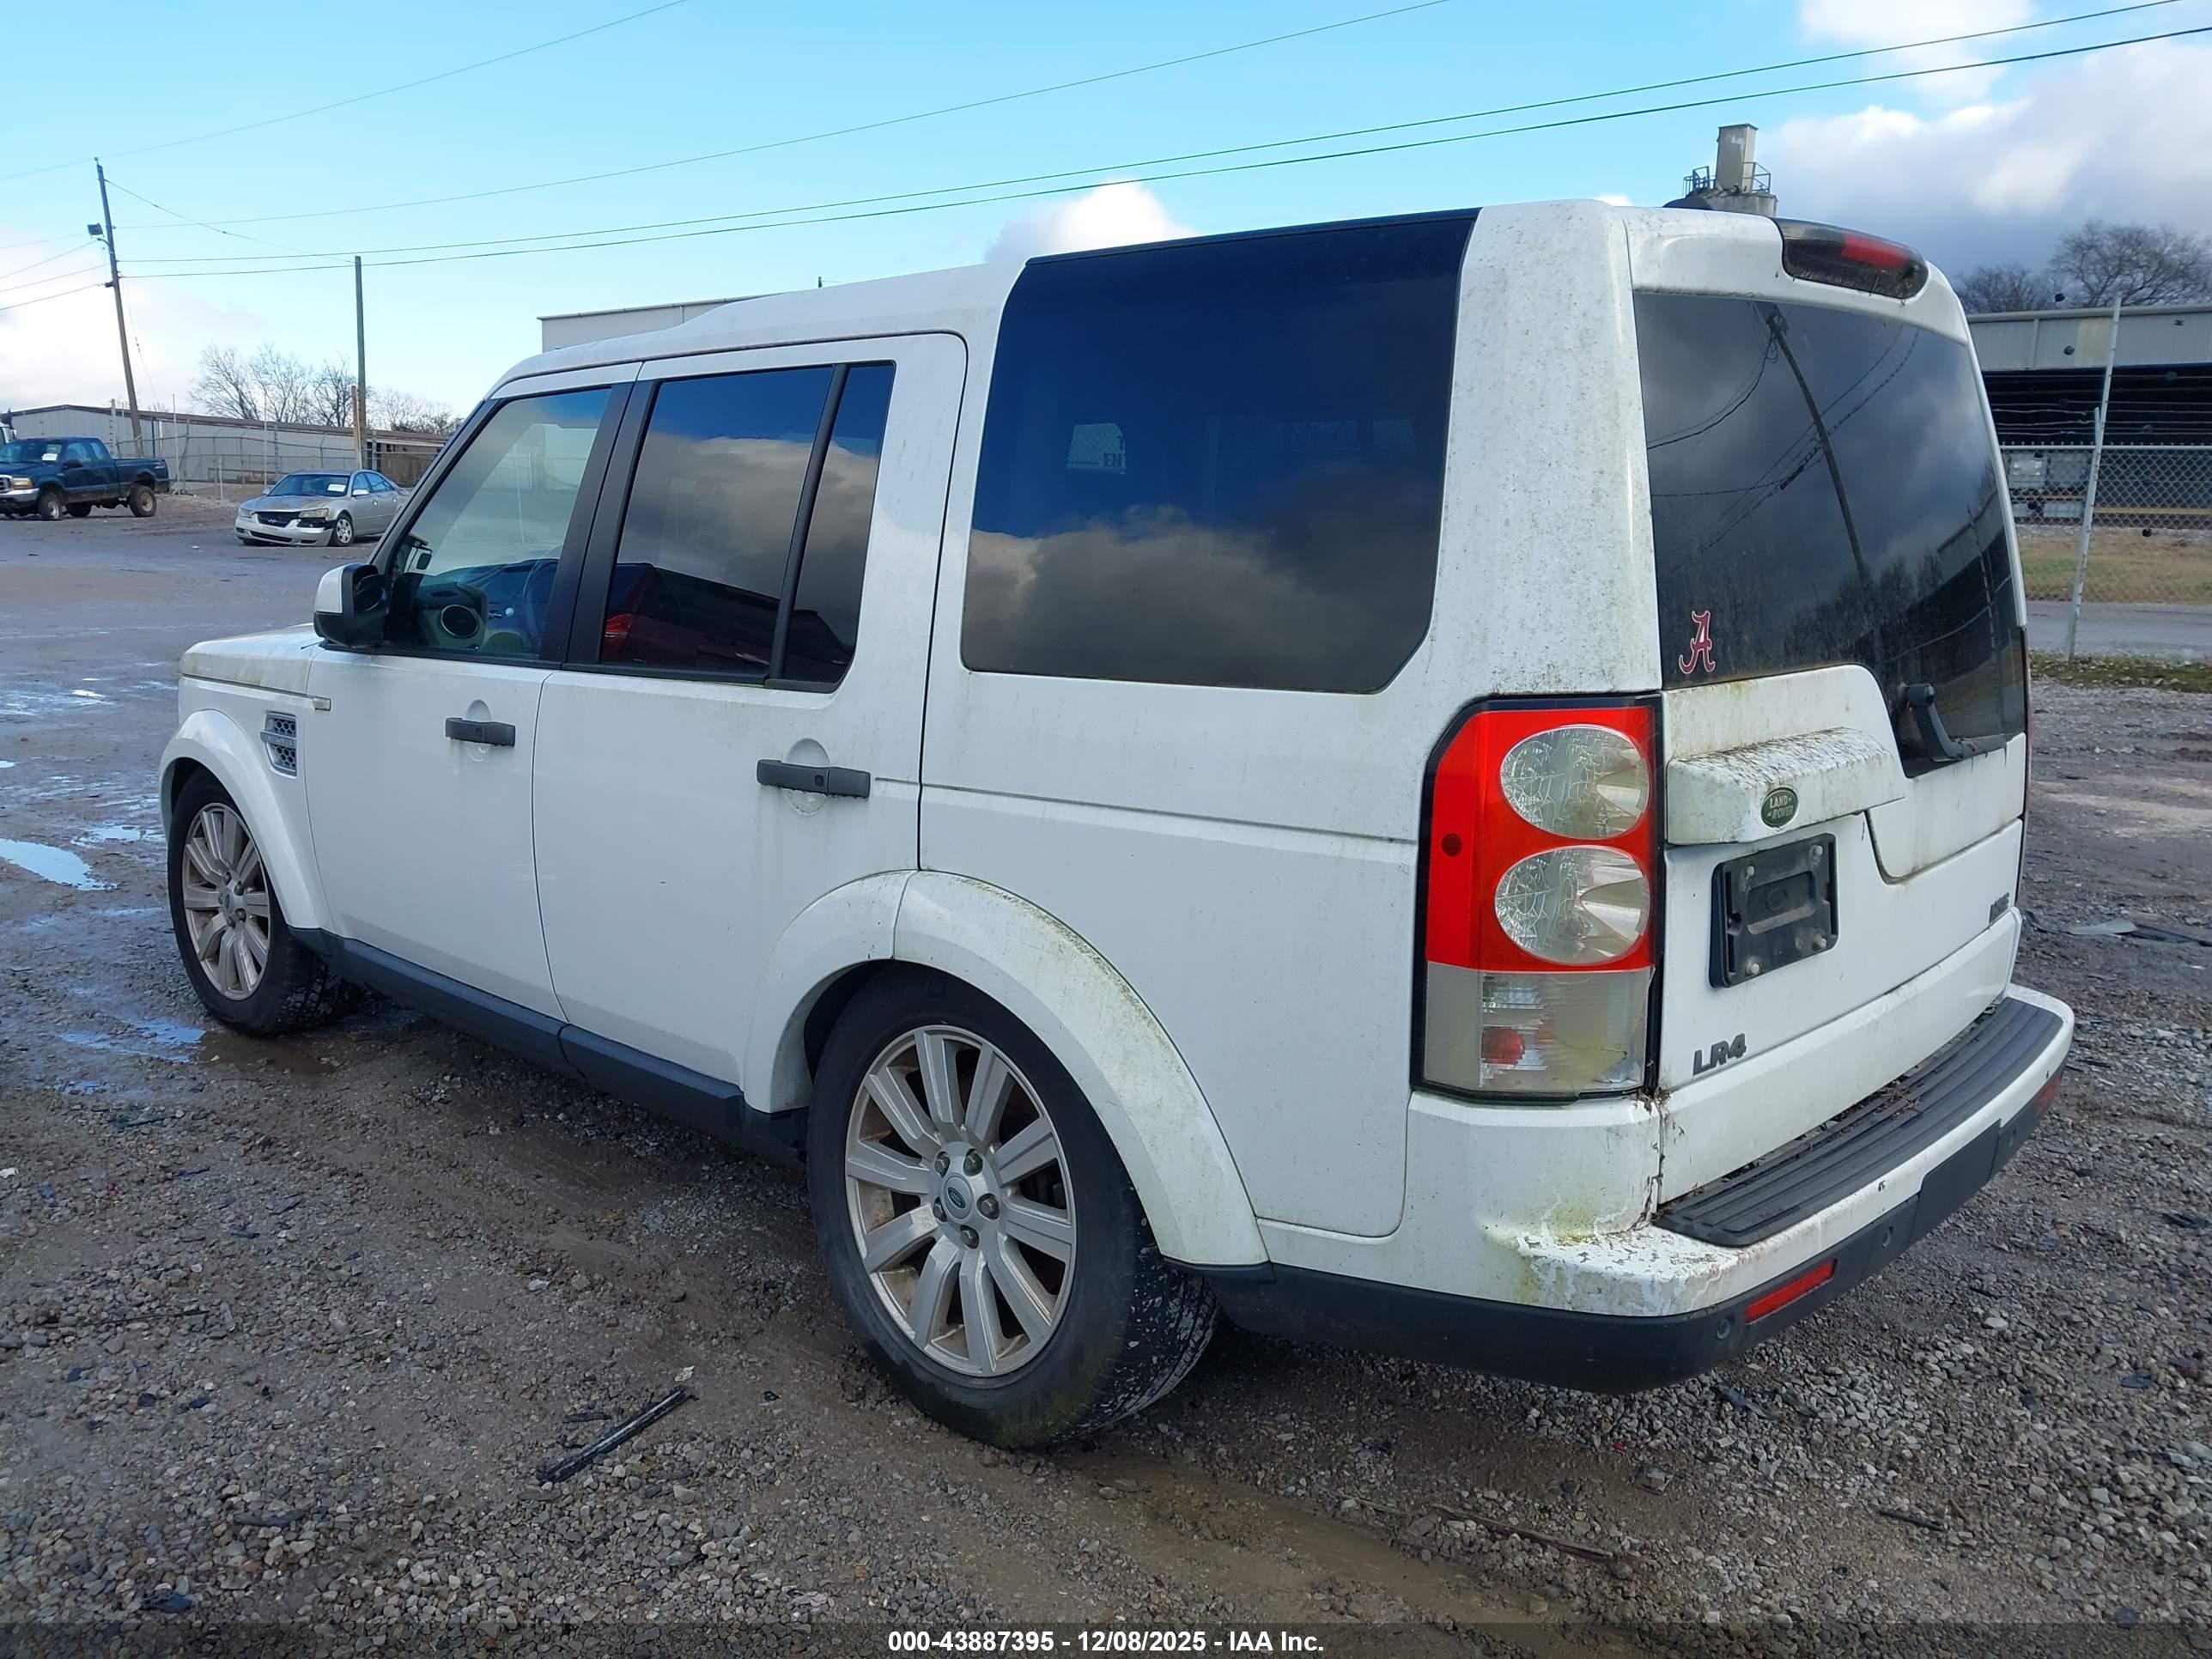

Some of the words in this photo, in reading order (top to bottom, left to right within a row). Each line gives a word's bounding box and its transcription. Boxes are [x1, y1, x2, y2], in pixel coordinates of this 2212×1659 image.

[1678, 610, 1716, 674] A
[1769, 794, 1789, 809] LAND
[1771, 805, 1794, 819] ROVER
[1692, 1032, 1747, 1076] LR4
